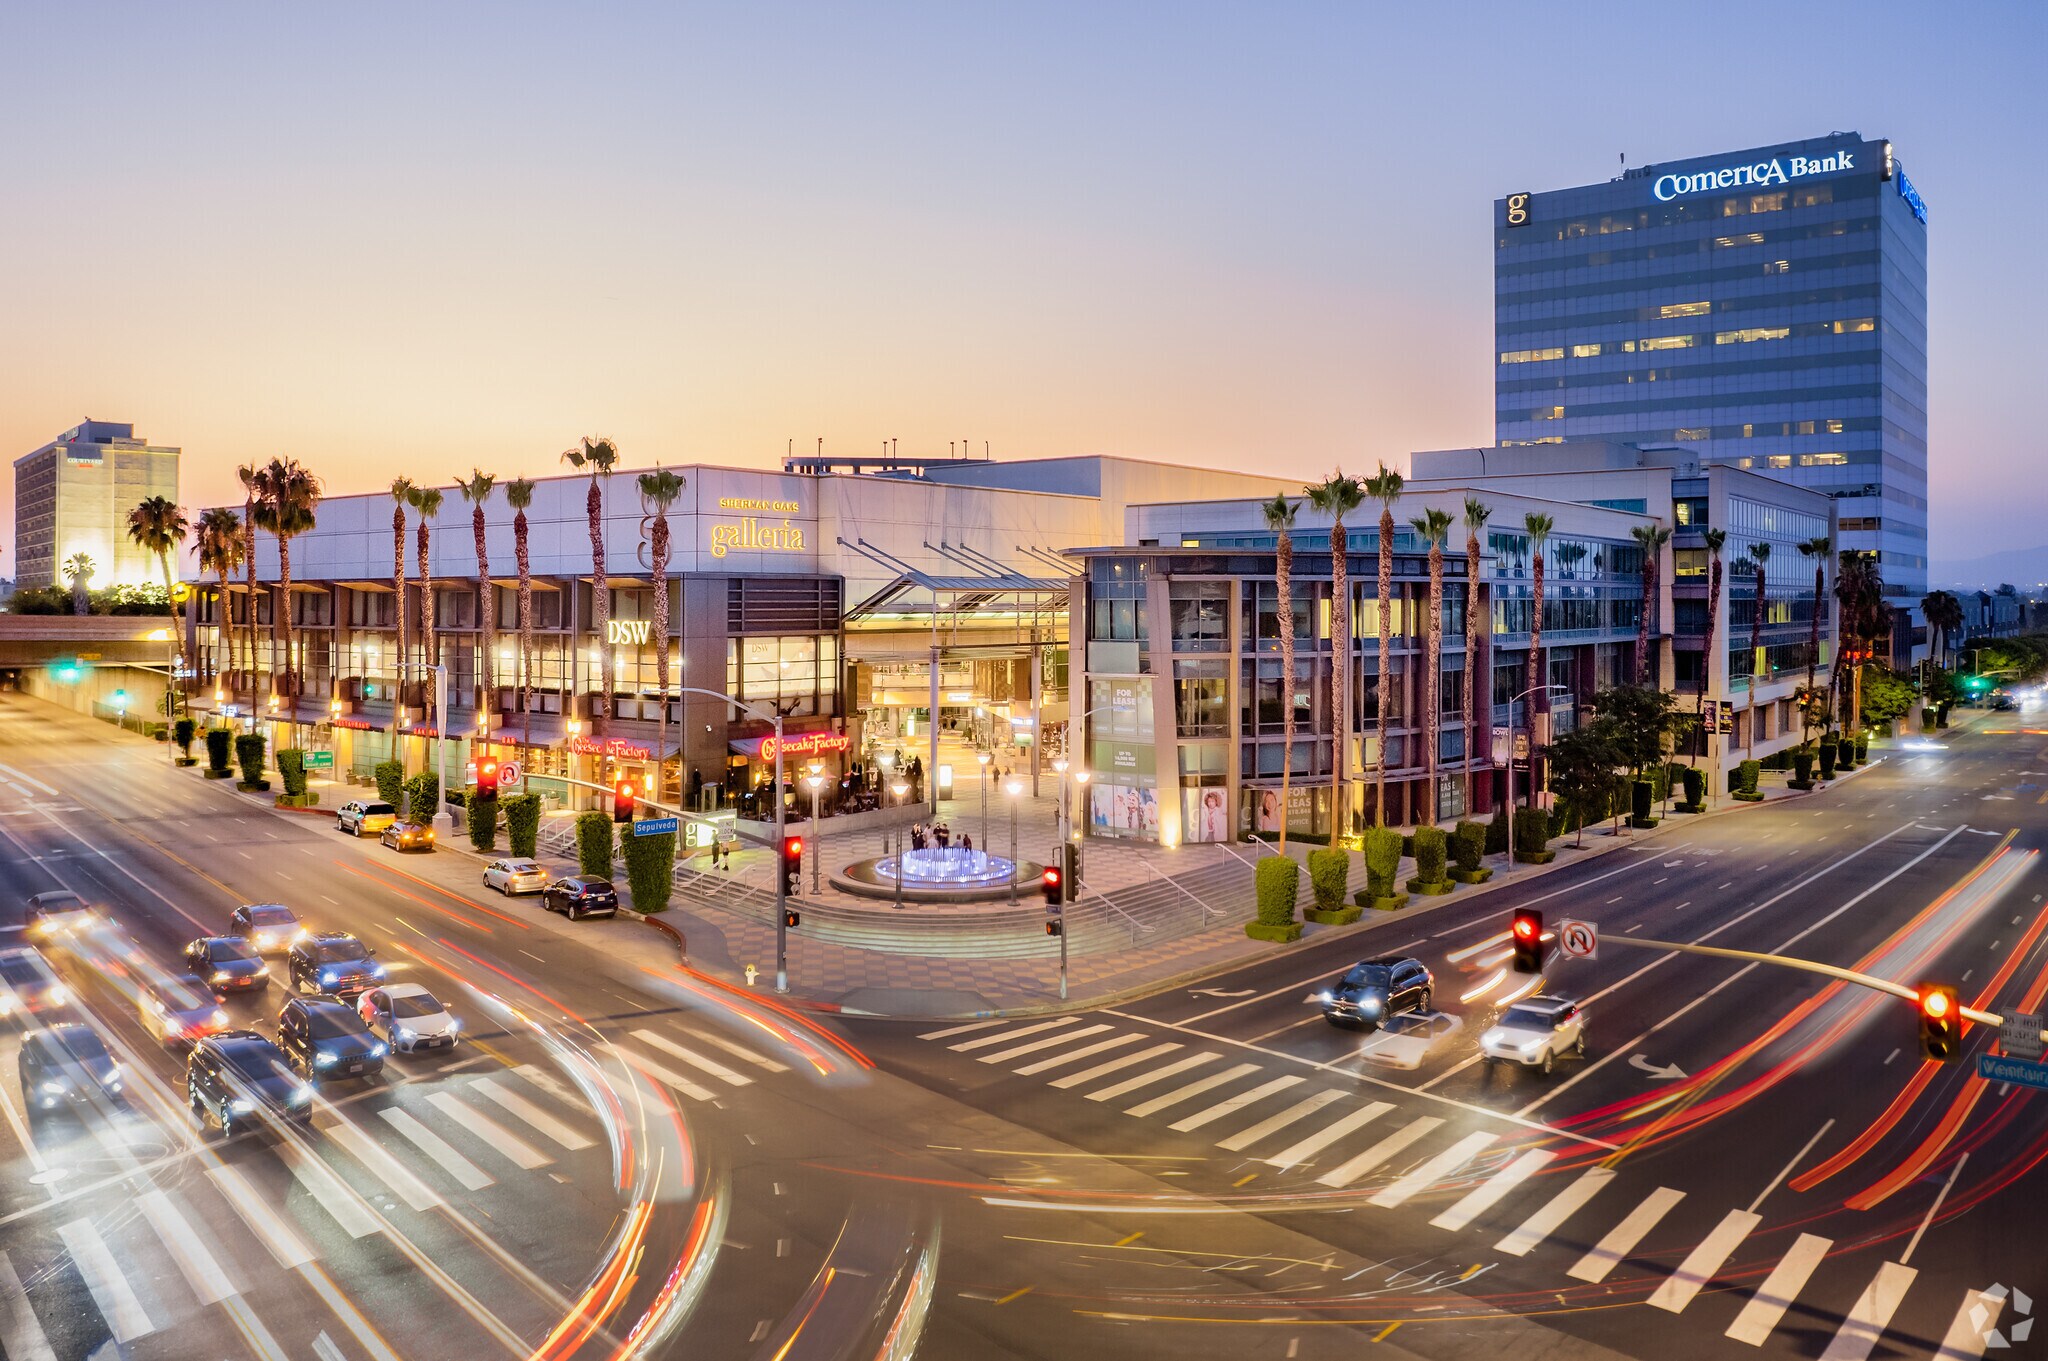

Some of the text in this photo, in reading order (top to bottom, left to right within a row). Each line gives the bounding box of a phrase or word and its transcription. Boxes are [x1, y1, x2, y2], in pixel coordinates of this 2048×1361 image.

[1790, 150, 1854, 177] Bank
[1508, 194, 1528, 224] g
[719, 497, 799, 512] SHERMAN OAKS
[711, 517, 806, 558] galleria
[607, 620, 651, 645] DSW
[752, 643, 768, 653] DSW
[1116, 689, 1132, 697] FOR
[1112, 697, 1136, 705] LEASE
[335, 720, 371, 729] RESTAURANT
[413, 727, 438, 736] BAKRY
[501, 735, 516, 744] BAR
[572, 738, 649, 760] Cheesecke Factory
[761, 733, 849, 760] Chesecake Factory
[1440, 781, 1455, 791] EASE
[1287, 787, 1307, 797] FOR
[1287, 798, 1311, 808] LEAS
[637, 821, 676, 832] Sepulveda
[685, 821, 698, 847] g
